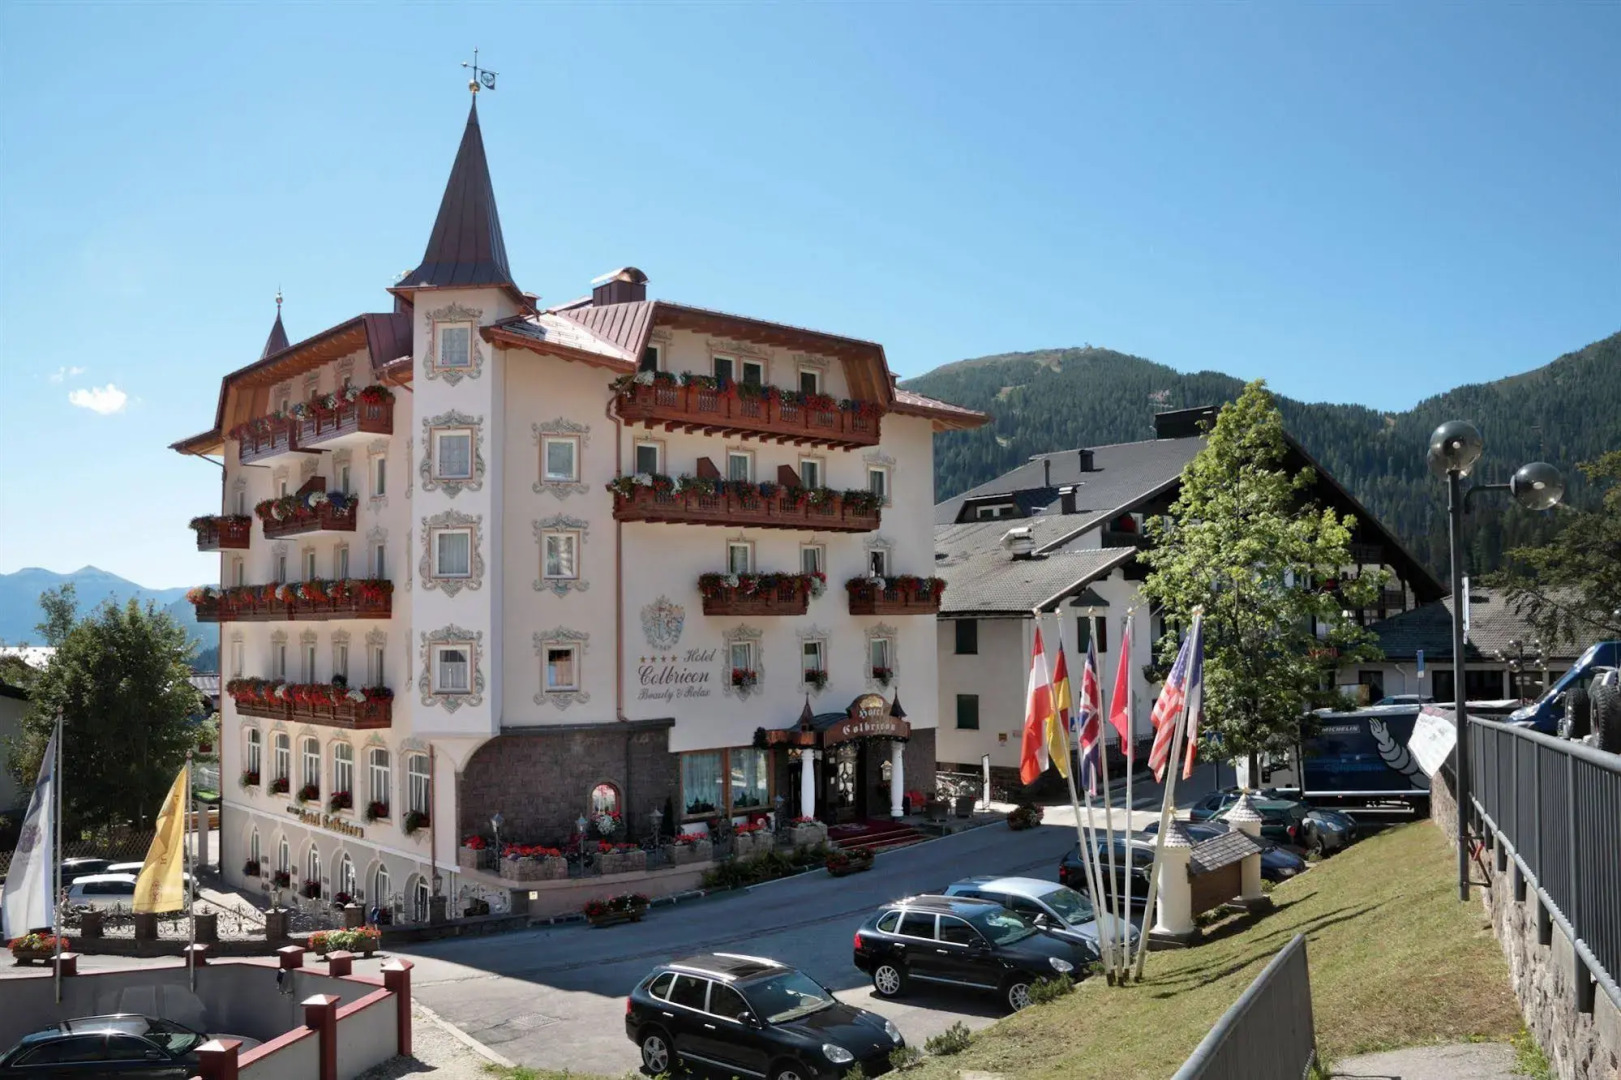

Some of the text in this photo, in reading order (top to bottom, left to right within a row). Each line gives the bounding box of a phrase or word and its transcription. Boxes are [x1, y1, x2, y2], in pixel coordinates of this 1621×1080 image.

[683, 648, 717, 662] Hotel
[638, 665, 709, 686] Colbricon
[637, 687, 673, 703] Beauty
[683, 685, 711, 698] Relax
[859, 707, 884, 719] Hotel
[842, 721, 896, 736] Colbricon
[1320, 724, 1359, 732] MICHELIN
